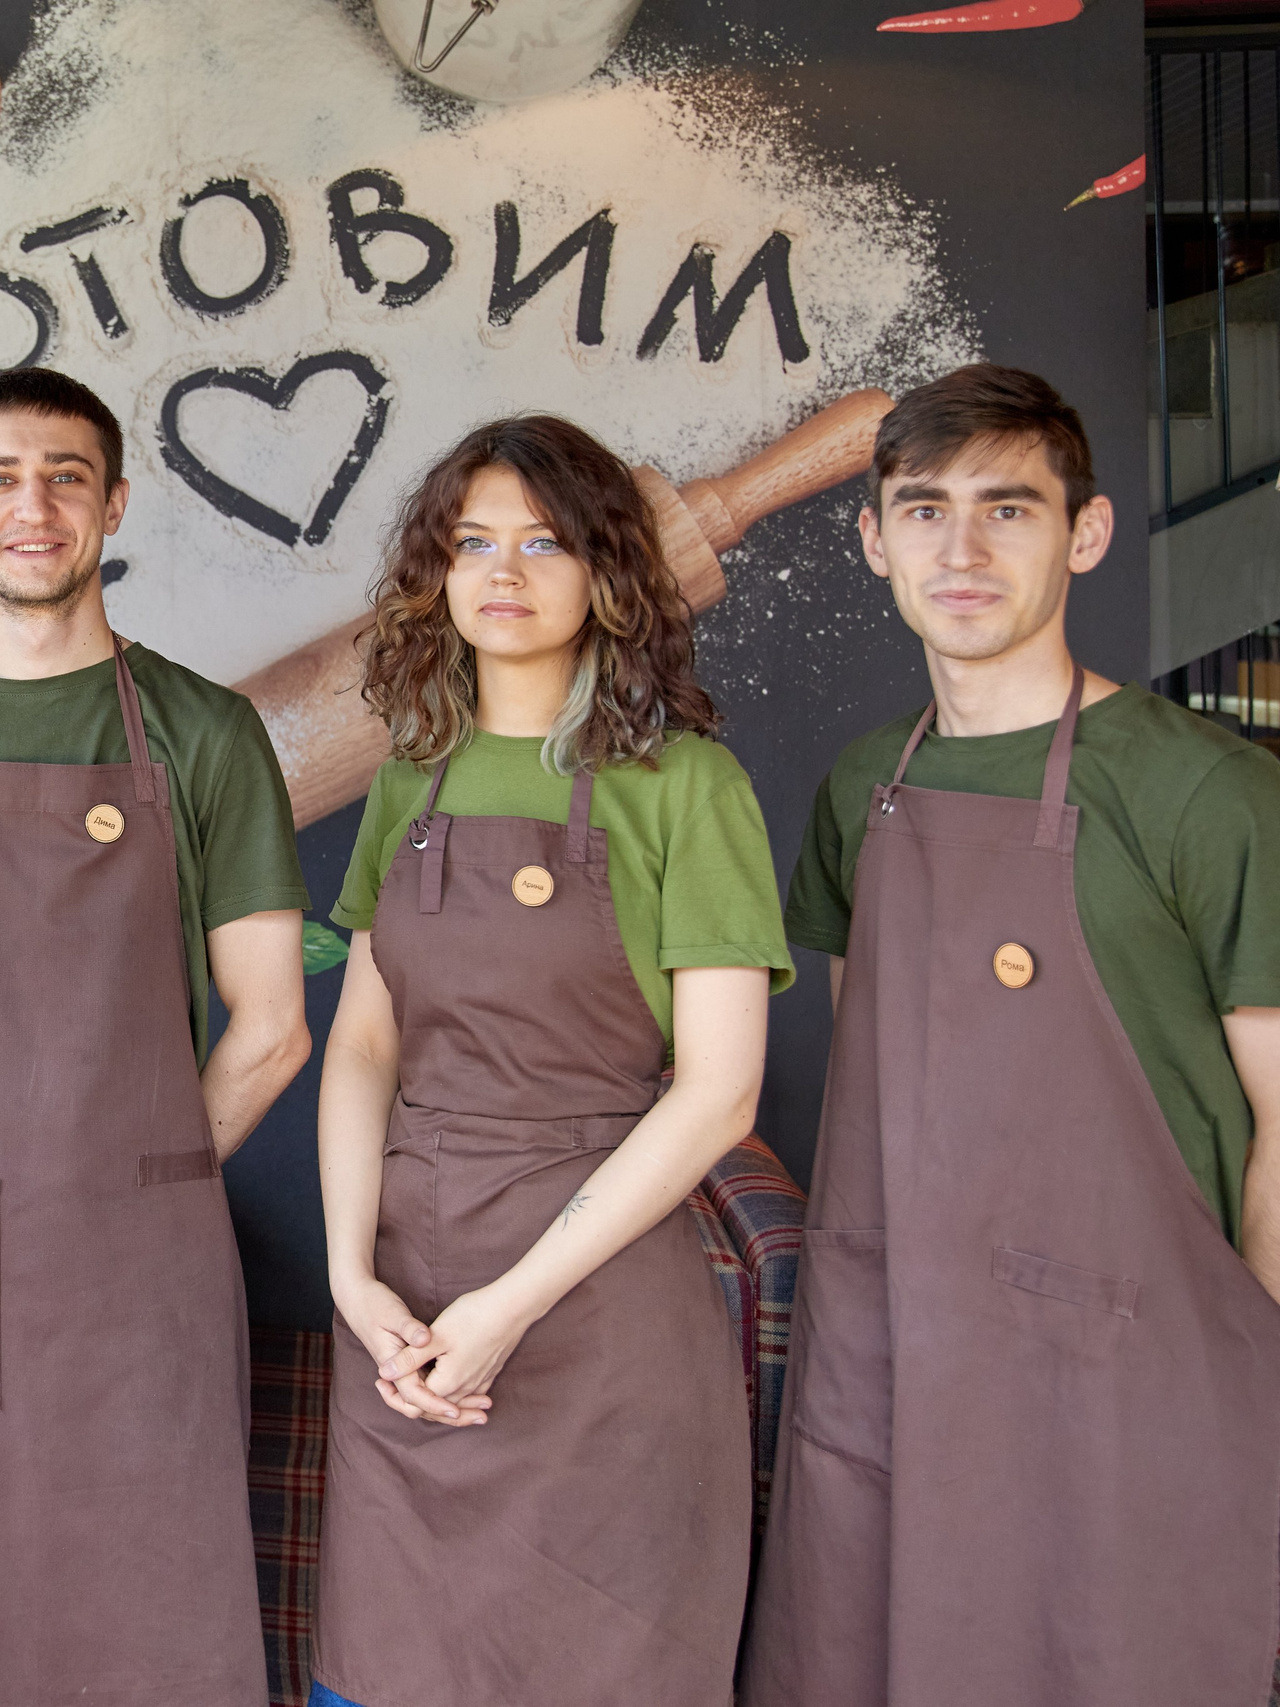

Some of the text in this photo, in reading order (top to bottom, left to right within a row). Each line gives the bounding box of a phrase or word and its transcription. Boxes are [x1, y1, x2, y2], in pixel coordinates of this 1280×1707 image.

[93, 816, 116, 830] Дима
[521, 880, 544, 891] Арина
[1000, 959, 1025, 972] Рома
